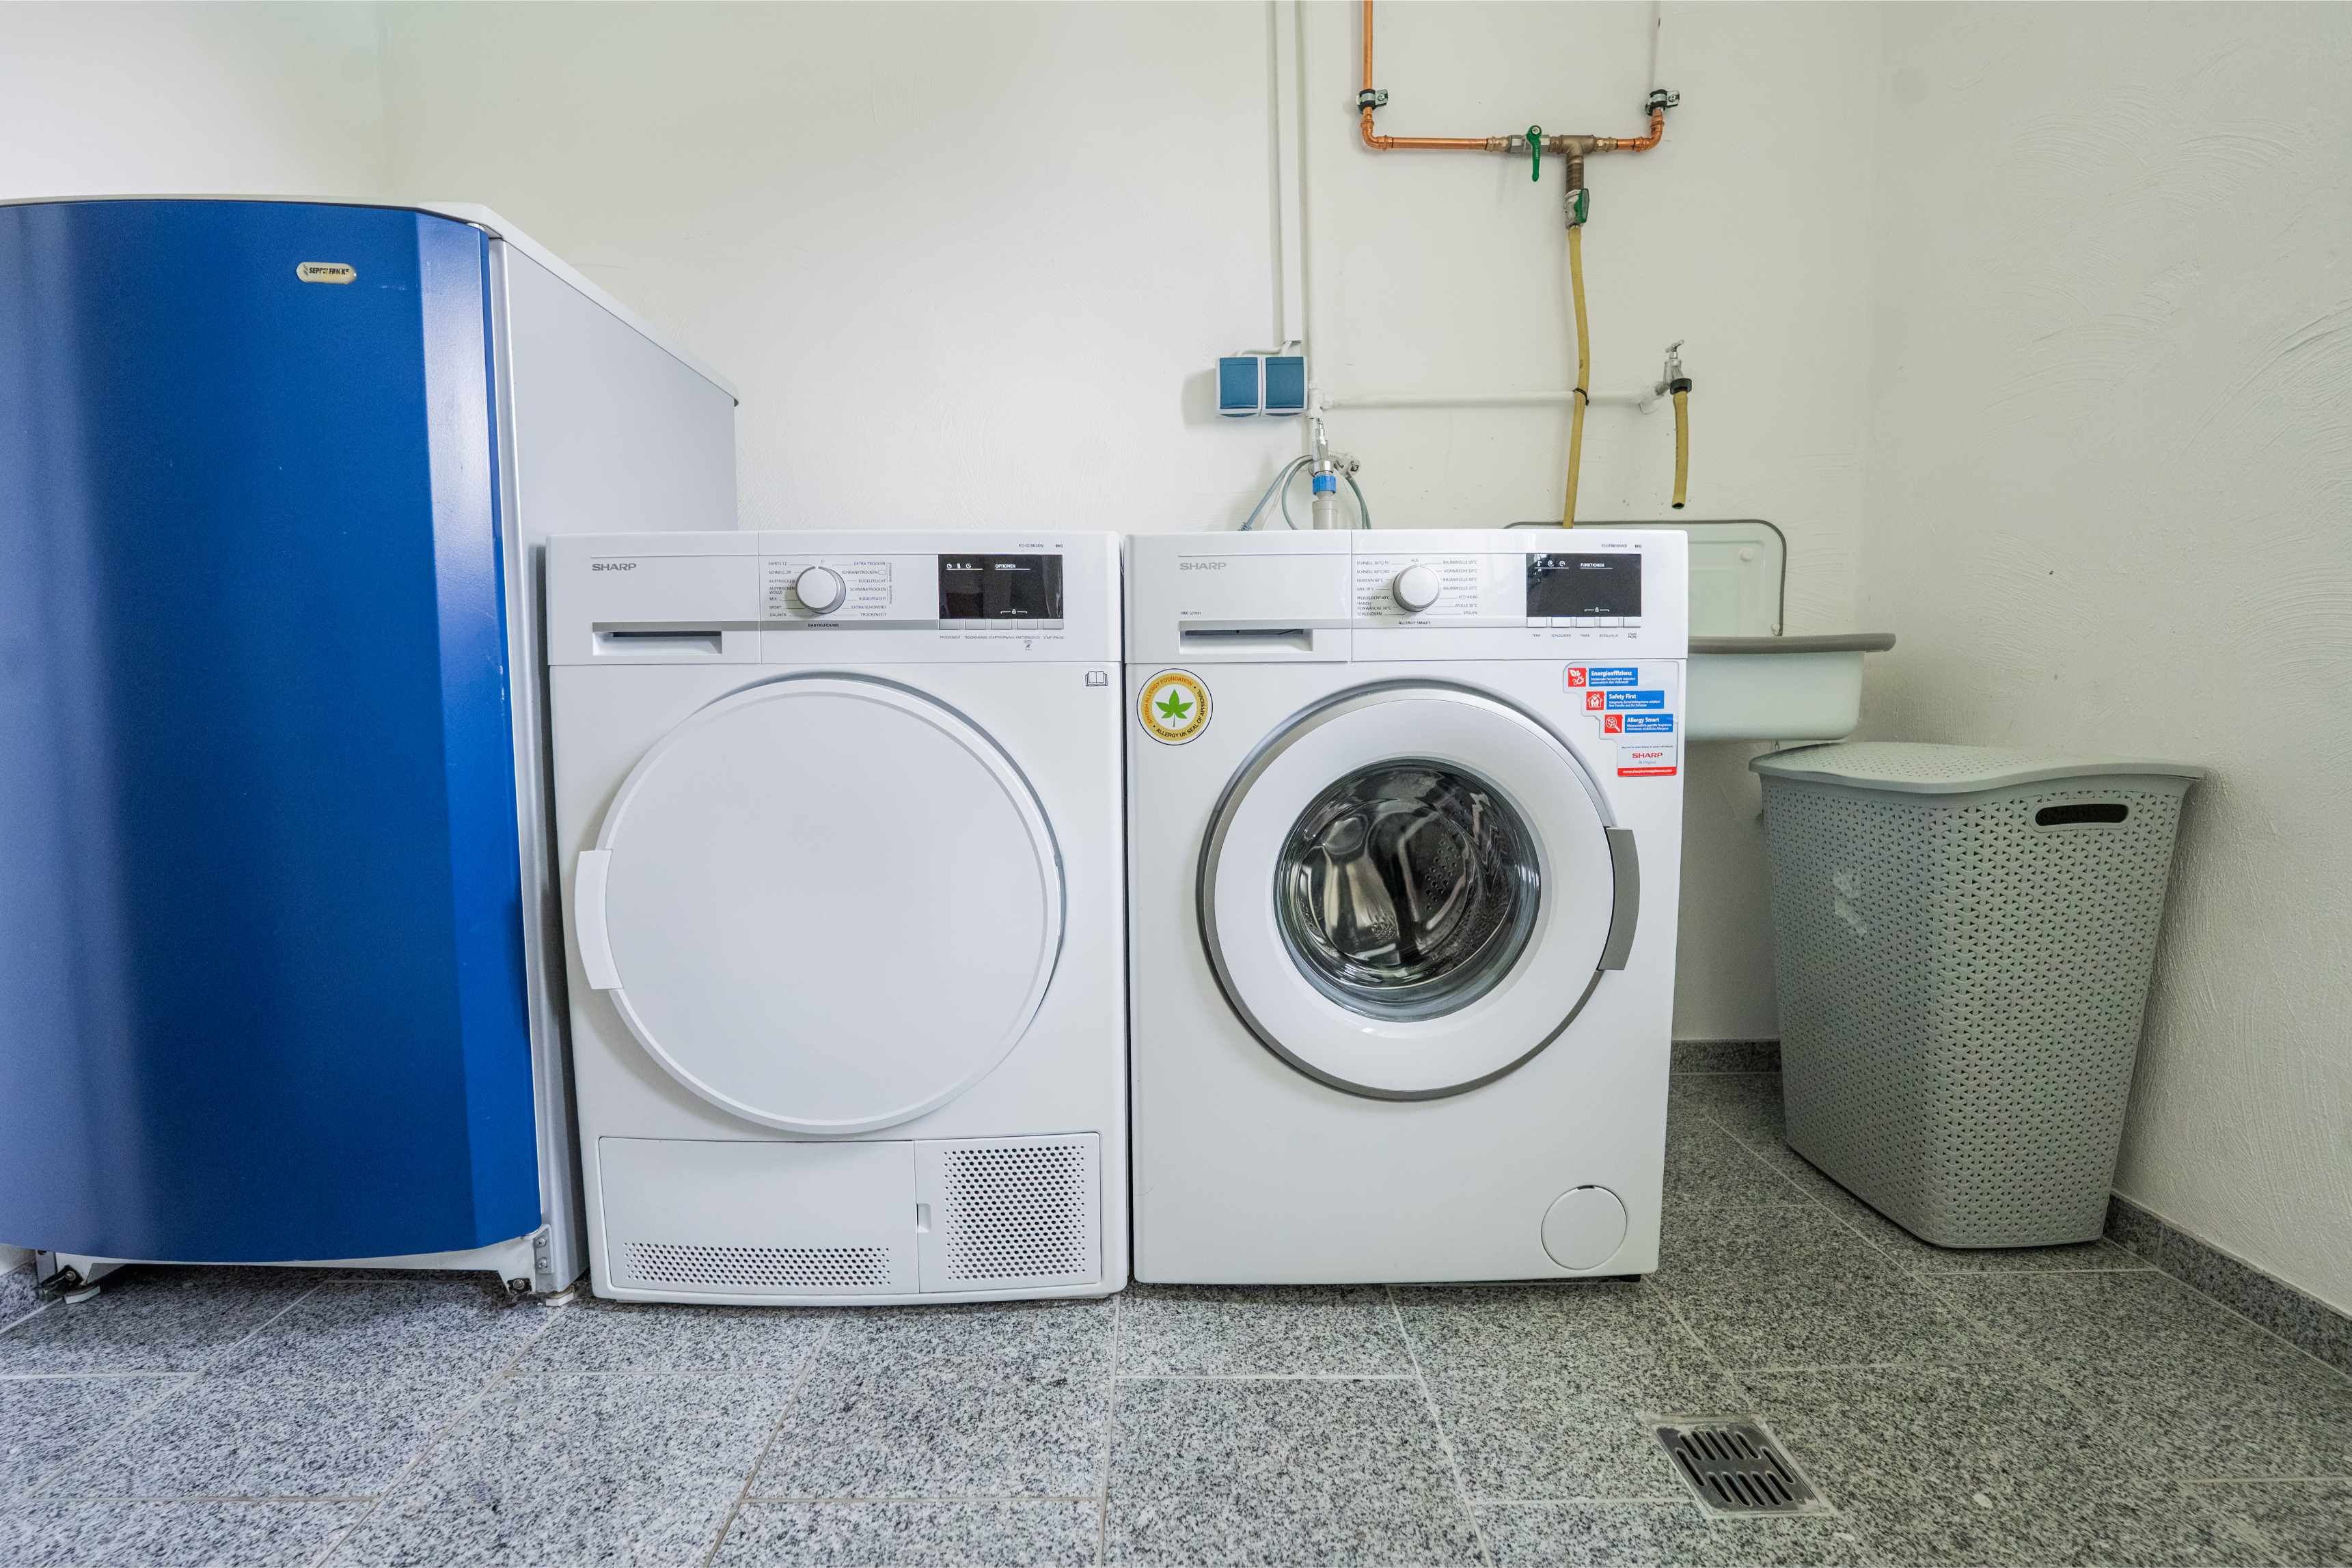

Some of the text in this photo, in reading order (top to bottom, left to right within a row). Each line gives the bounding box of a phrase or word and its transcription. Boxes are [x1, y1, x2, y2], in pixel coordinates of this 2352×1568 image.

[592, 563, 637, 571] SHARP
[1160, 676, 1193, 686] FOUNDATION
[1156, 728, 1179, 737] ALLERGY
[1187, 724, 1199, 734] SEAL
[1197, 689, 1205, 716] APPROVAL
